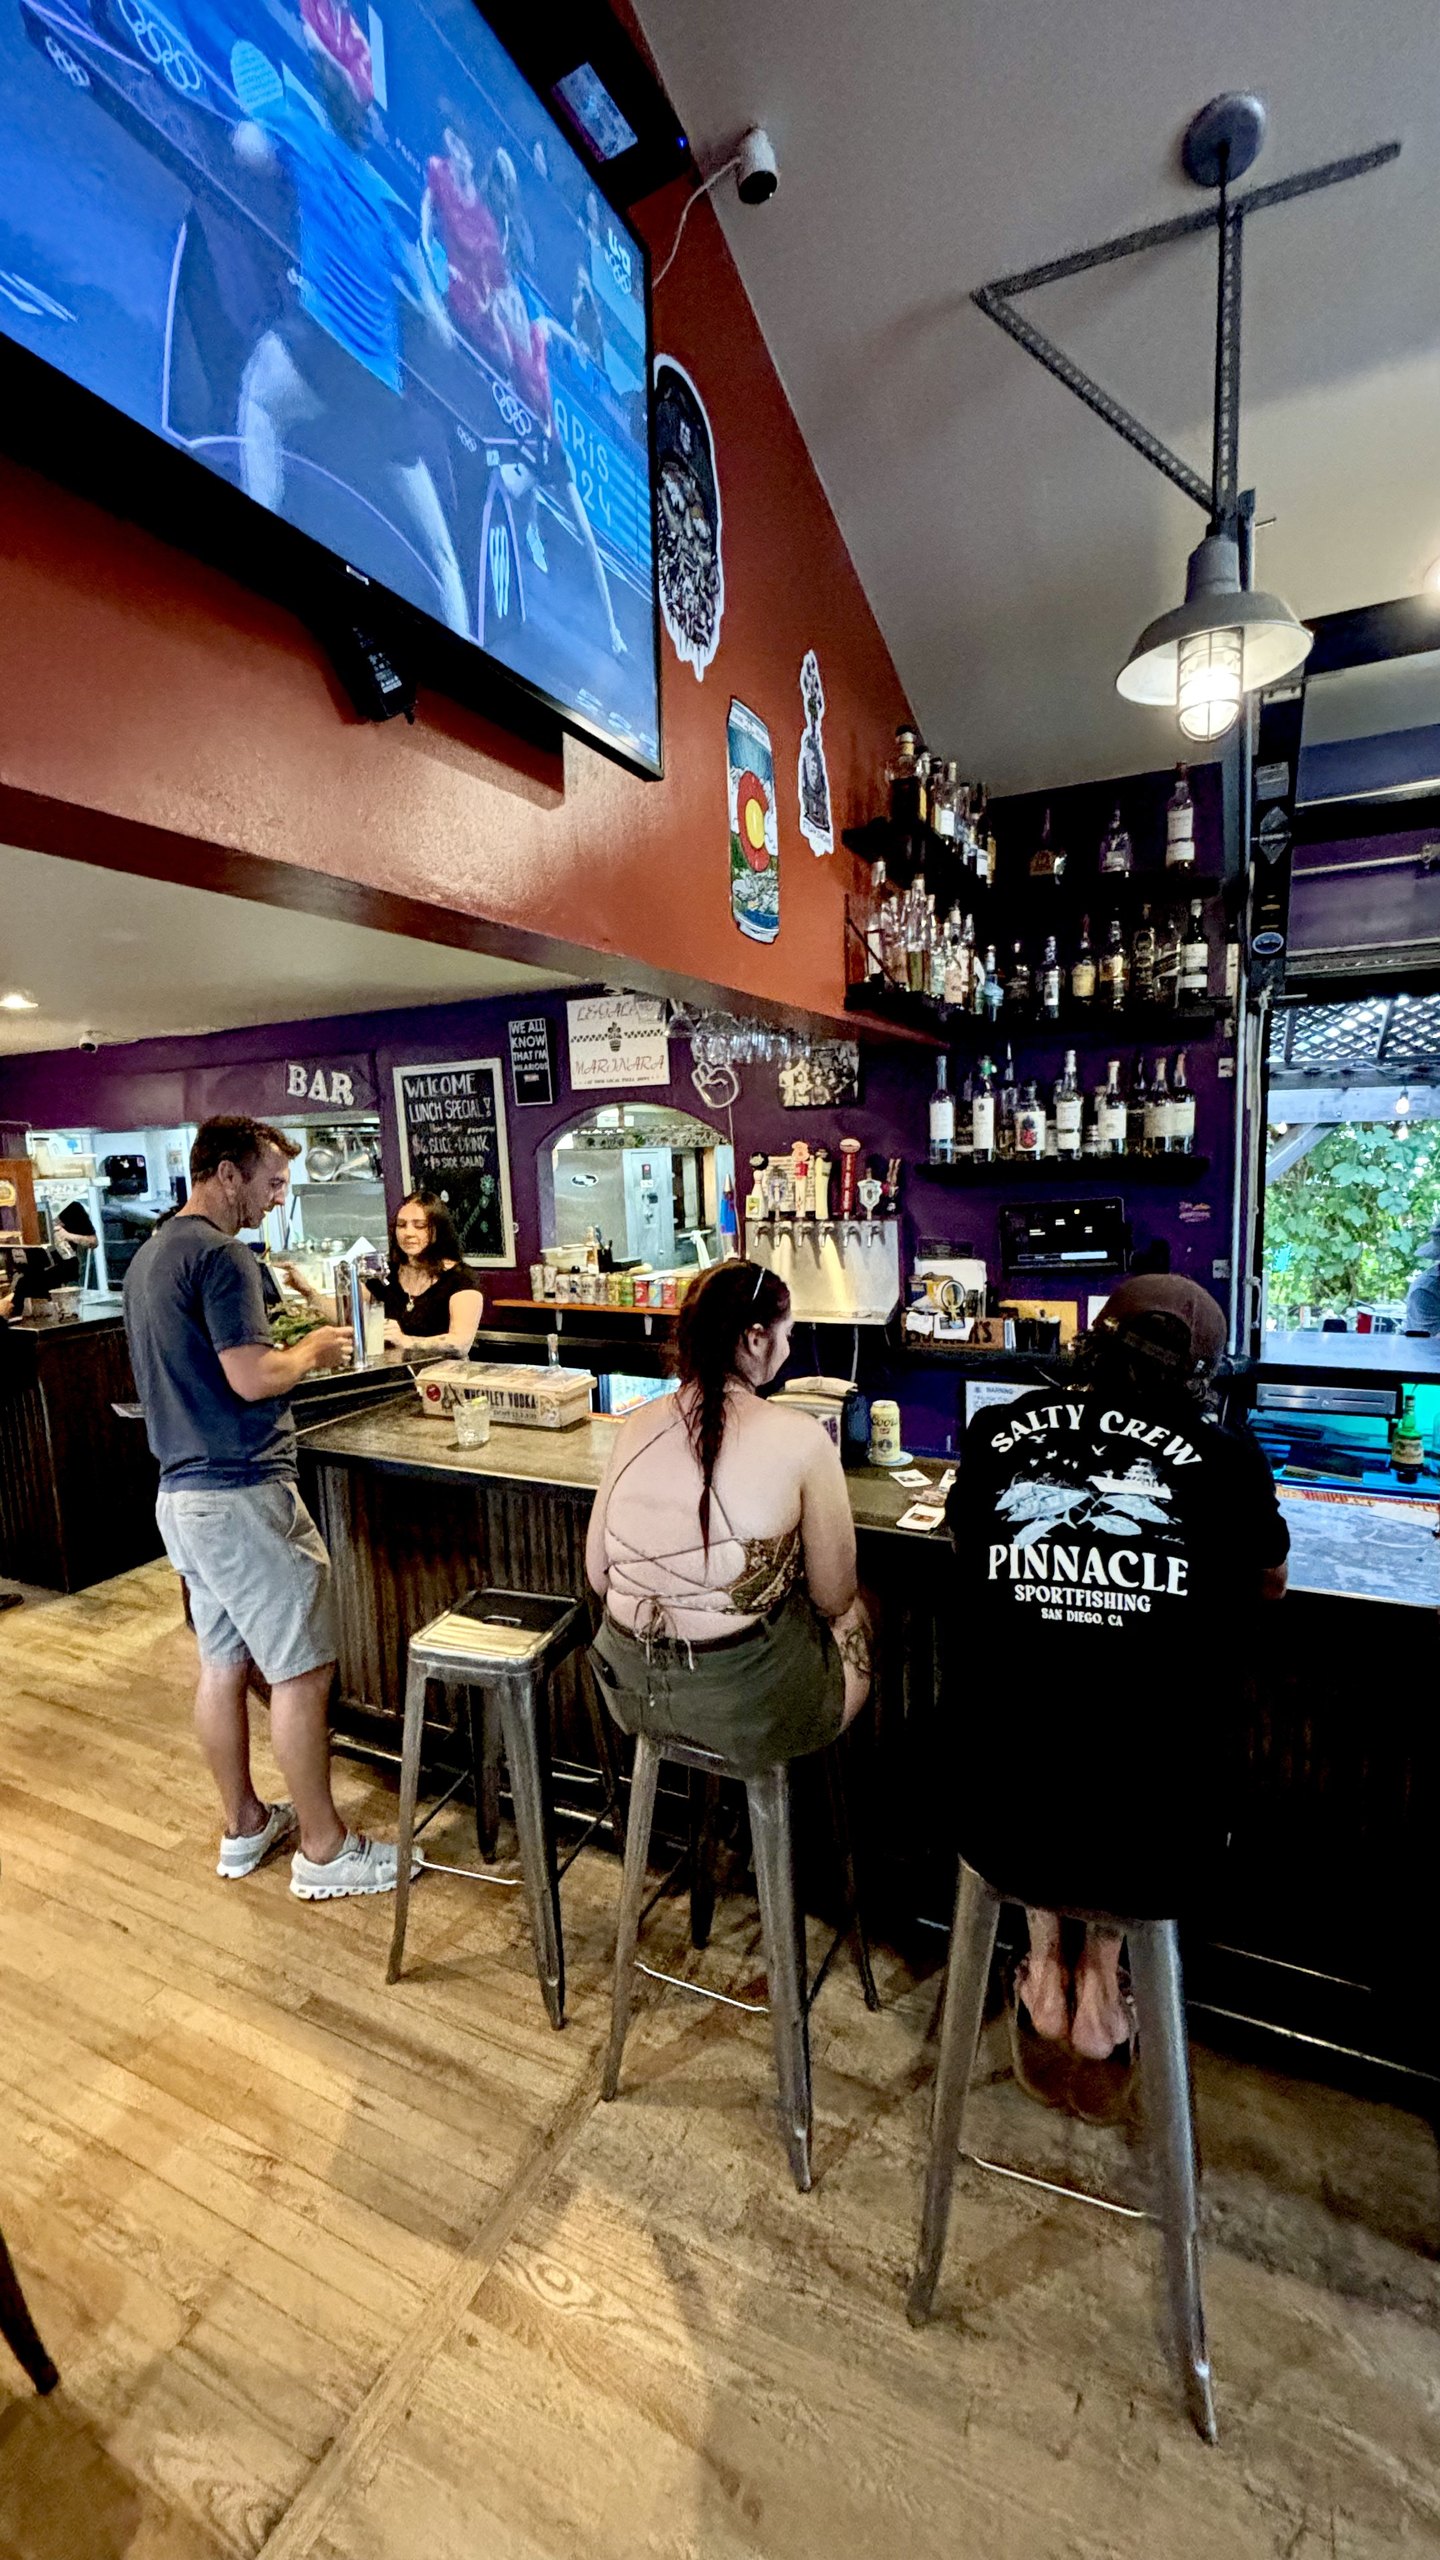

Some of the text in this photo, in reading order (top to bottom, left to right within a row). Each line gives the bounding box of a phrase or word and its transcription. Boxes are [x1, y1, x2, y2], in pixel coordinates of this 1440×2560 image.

[554, 398, 610, 484] ARiS
[511, 1020, 545, 1034] WE ALL
[511, 1035, 545, 1049] KNOW
[512, 1051, 533, 1061] THAT
[573, 1054, 665, 1076] MARINARA
[287, 1064, 354, 1106] BAR
[404, 1073, 477, 1098] WELCOME
[408, 1101, 443, 1123] LUNCH
[508, 1391, 537, 1409] VODKA
[990, 1404, 1202, 1466] SALTY CREW
[988, 1544, 1189, 1597] PINNACLE
[1014, 1584, 1152, 1613] SPORTFISHING
[1041, 1607, 1124, 1627] SAN DIEGO, CA
